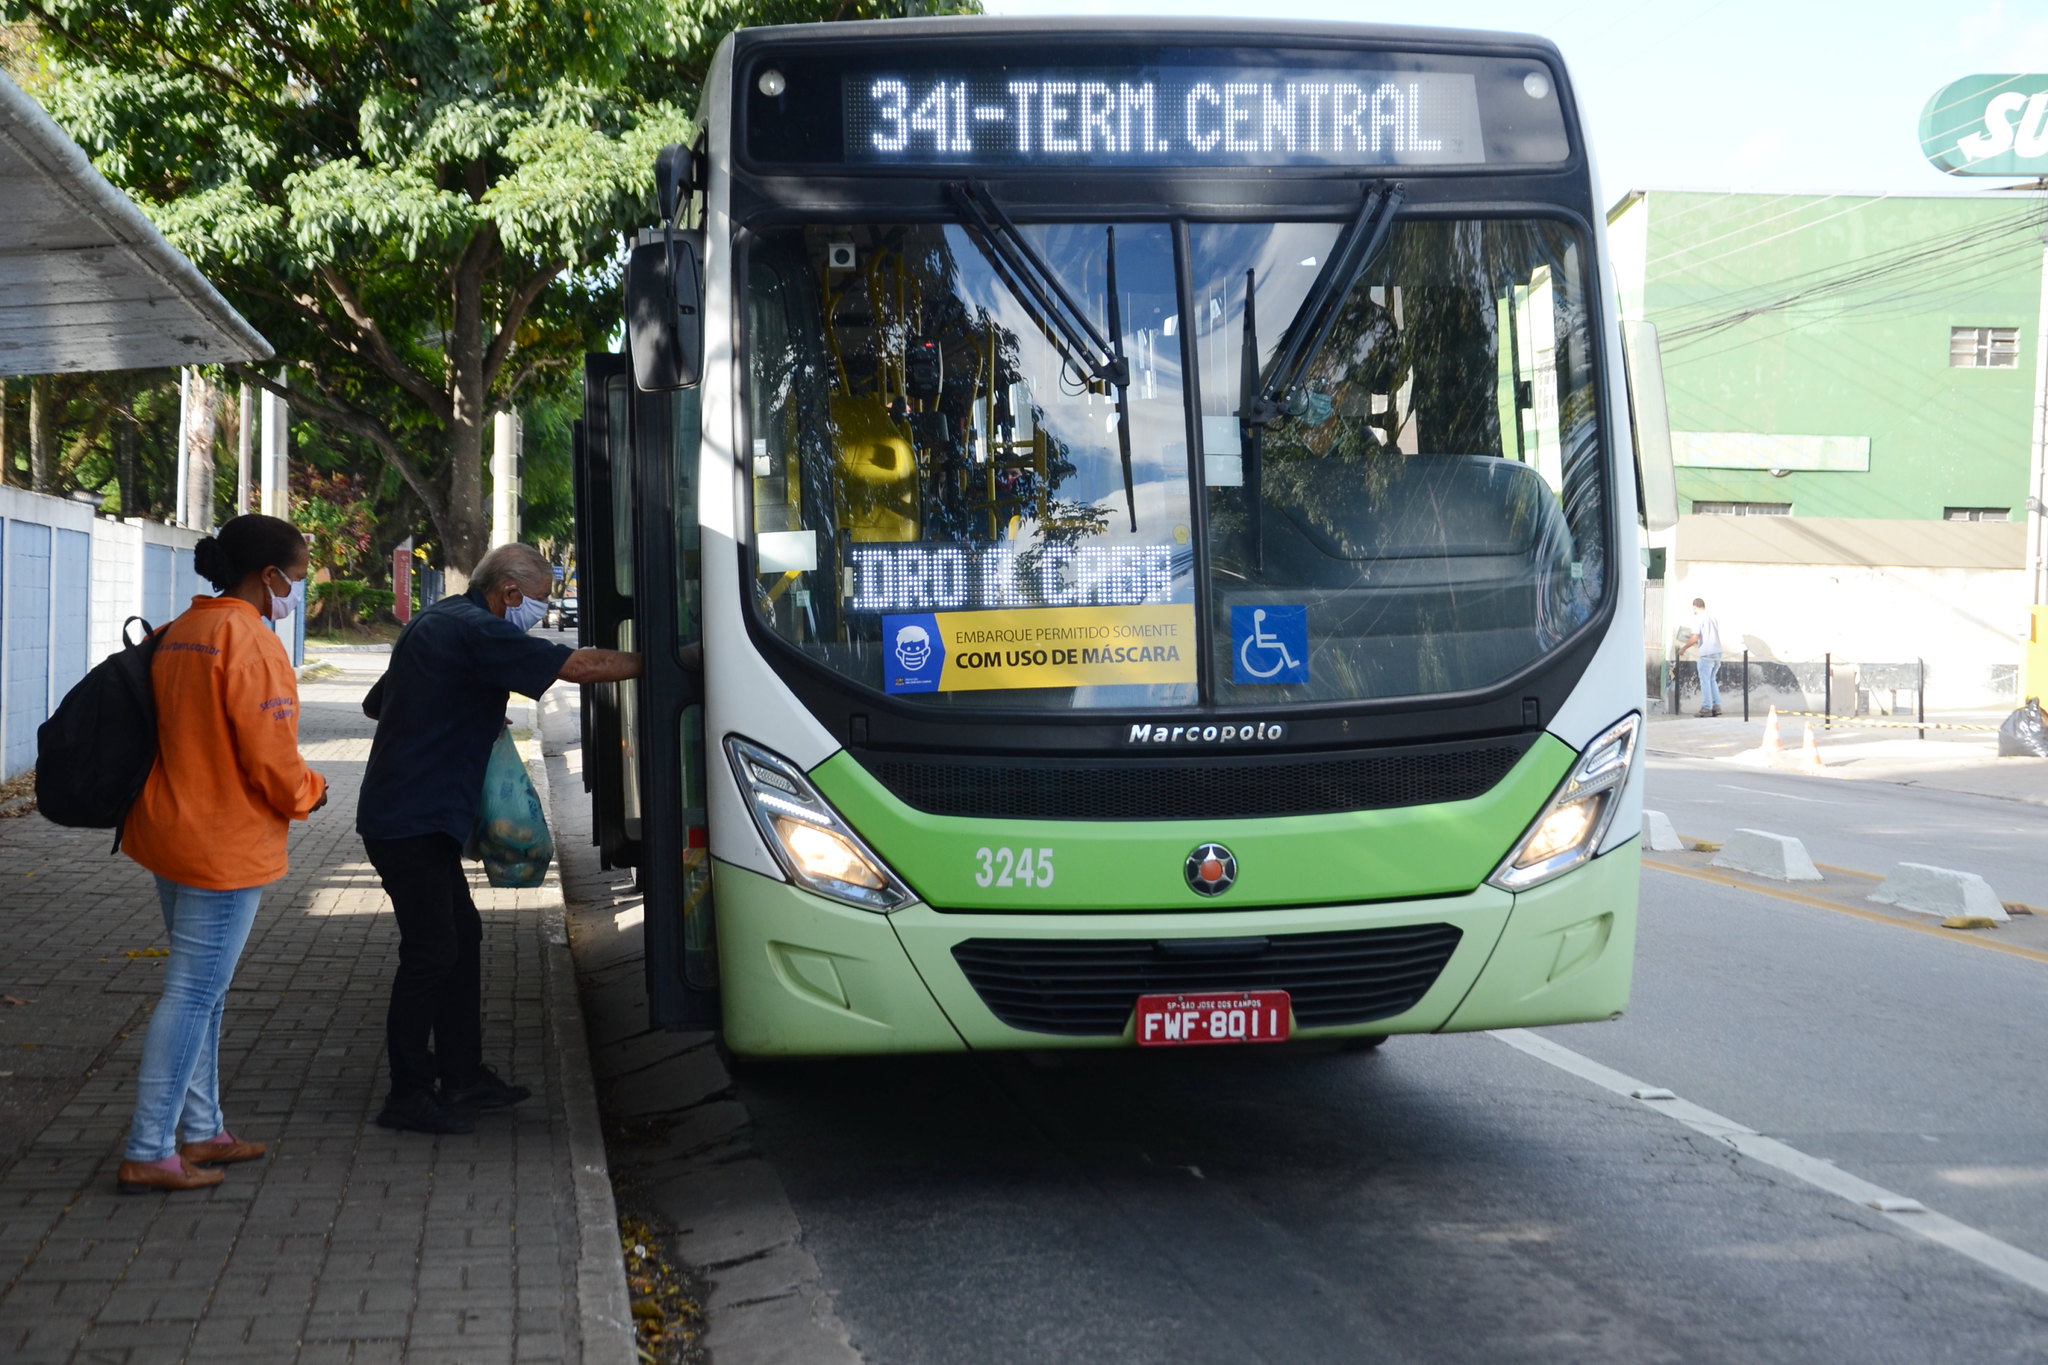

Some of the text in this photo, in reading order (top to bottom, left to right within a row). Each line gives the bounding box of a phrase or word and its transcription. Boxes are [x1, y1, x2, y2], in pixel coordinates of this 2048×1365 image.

[1187, 82, 1442, 153] CENTRAL
[956, 623, 1178, 645] EMBARQUE PERMITIDO SOMENTE
[956, 644, 1180, 669] COM USO DE MÁSCARA
[1128, 722, 1283, 743] Marcopolo
[975, 847, 1054, 888] 3245
[1217, 1000, 1232, 1009] DOS
[1233, 999, 1261, 1008] CAMPOS
